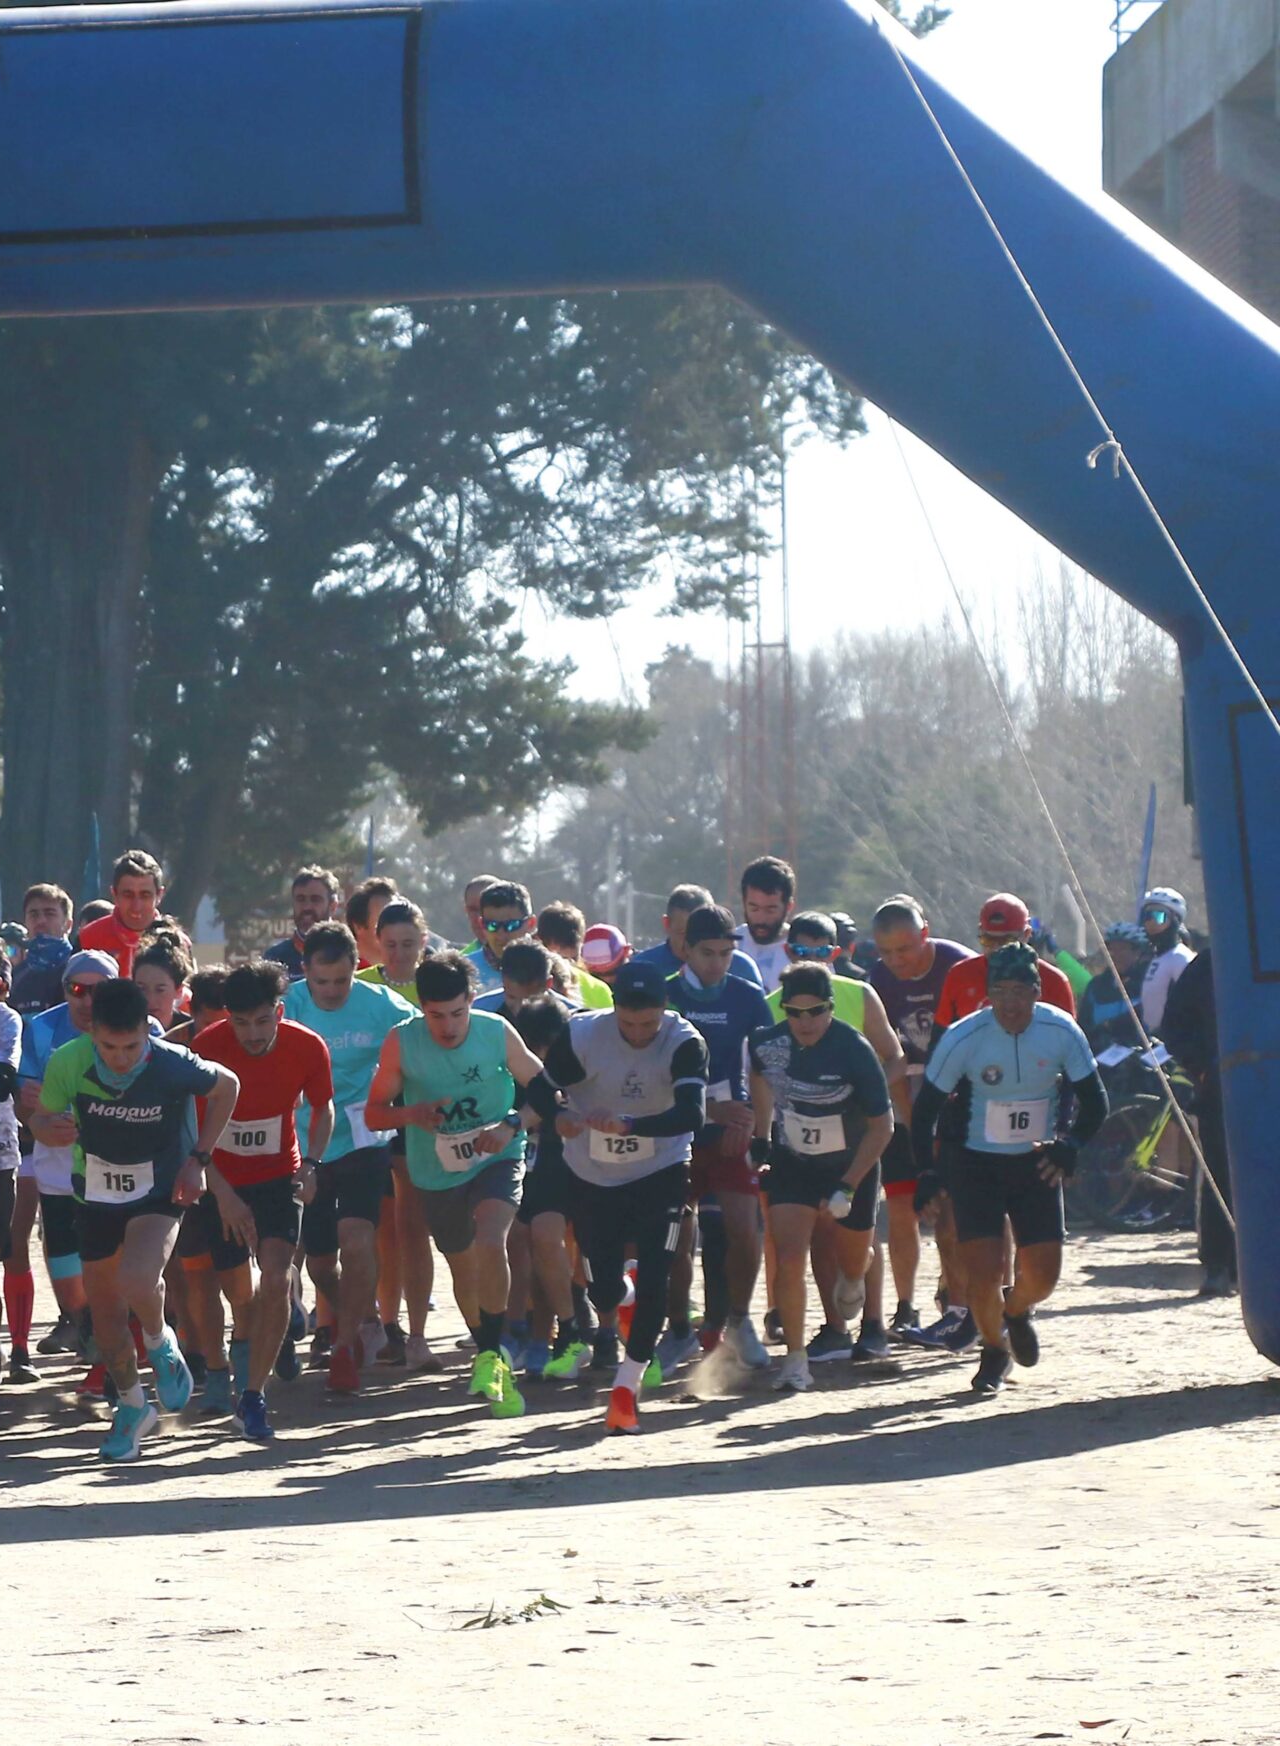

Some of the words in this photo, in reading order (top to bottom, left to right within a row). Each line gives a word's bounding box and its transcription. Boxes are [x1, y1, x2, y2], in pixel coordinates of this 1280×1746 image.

[1009, 1112, 1030, 1130] 16
[231, 1130, 267, 1147] 100
[802, 1128, 821, 1145] 27
[604, 1137, 640, 1155] 125
[103, 1171, 136, 1192] 115
